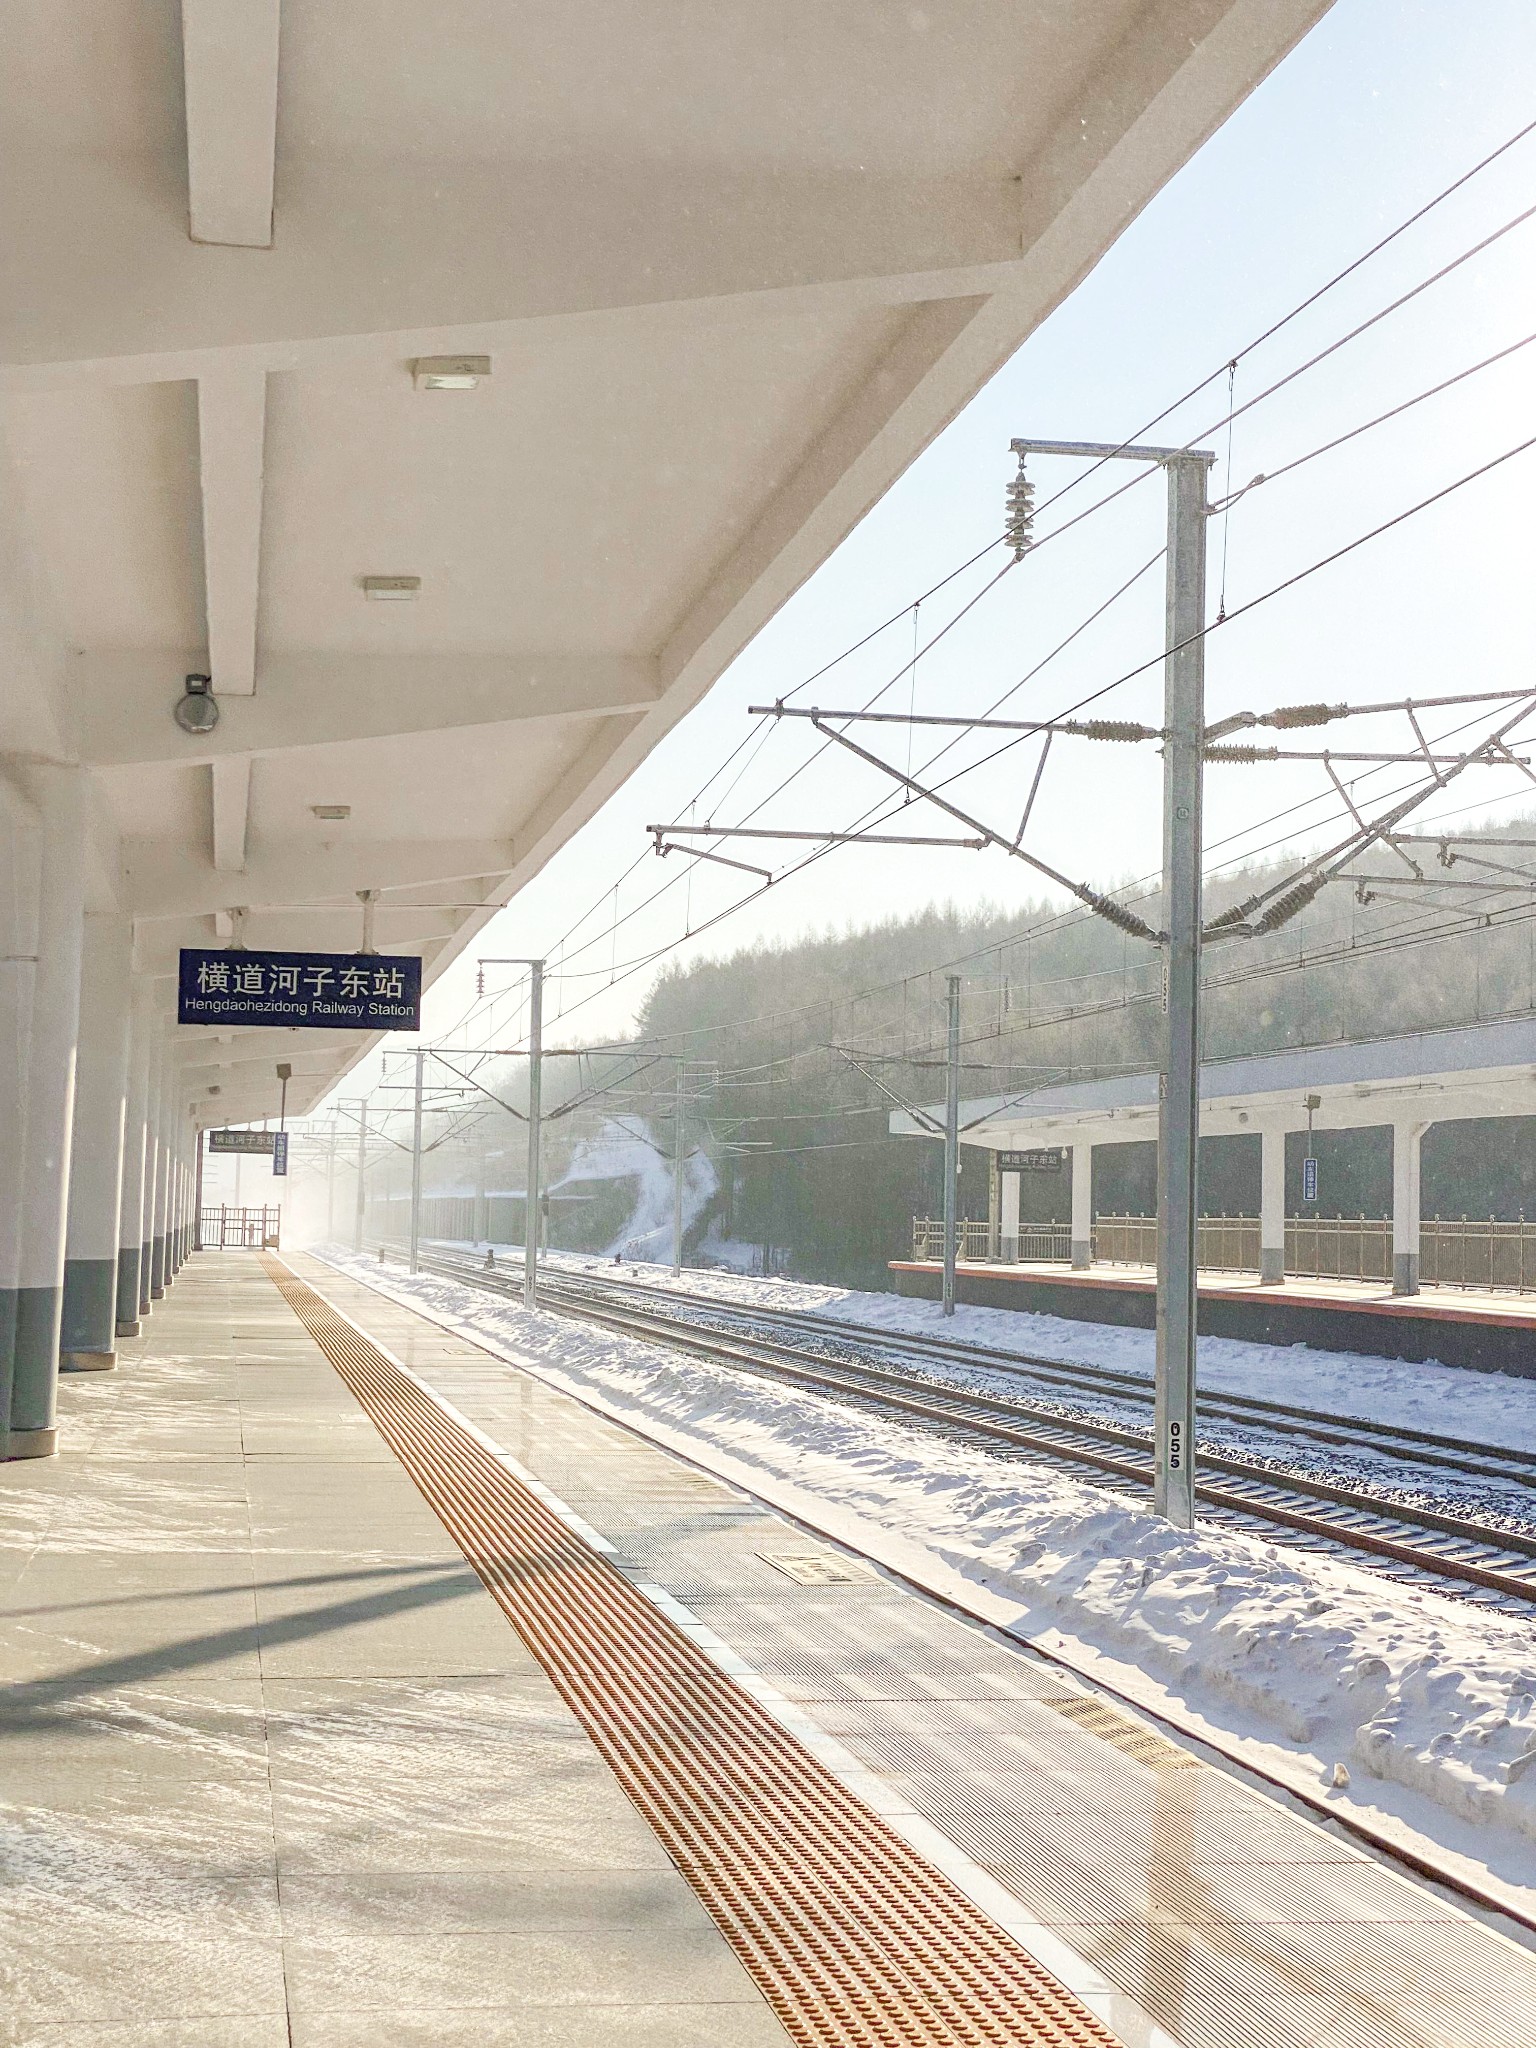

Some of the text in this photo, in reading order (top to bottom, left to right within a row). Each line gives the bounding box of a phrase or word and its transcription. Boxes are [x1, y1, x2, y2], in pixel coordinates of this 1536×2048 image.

[197, 960, 406, 999] 横道河子东站
[185, 997, 414, 1017] Hengdaohezidong Railway Station
[1170, 1422, 1181, 1469] 055
